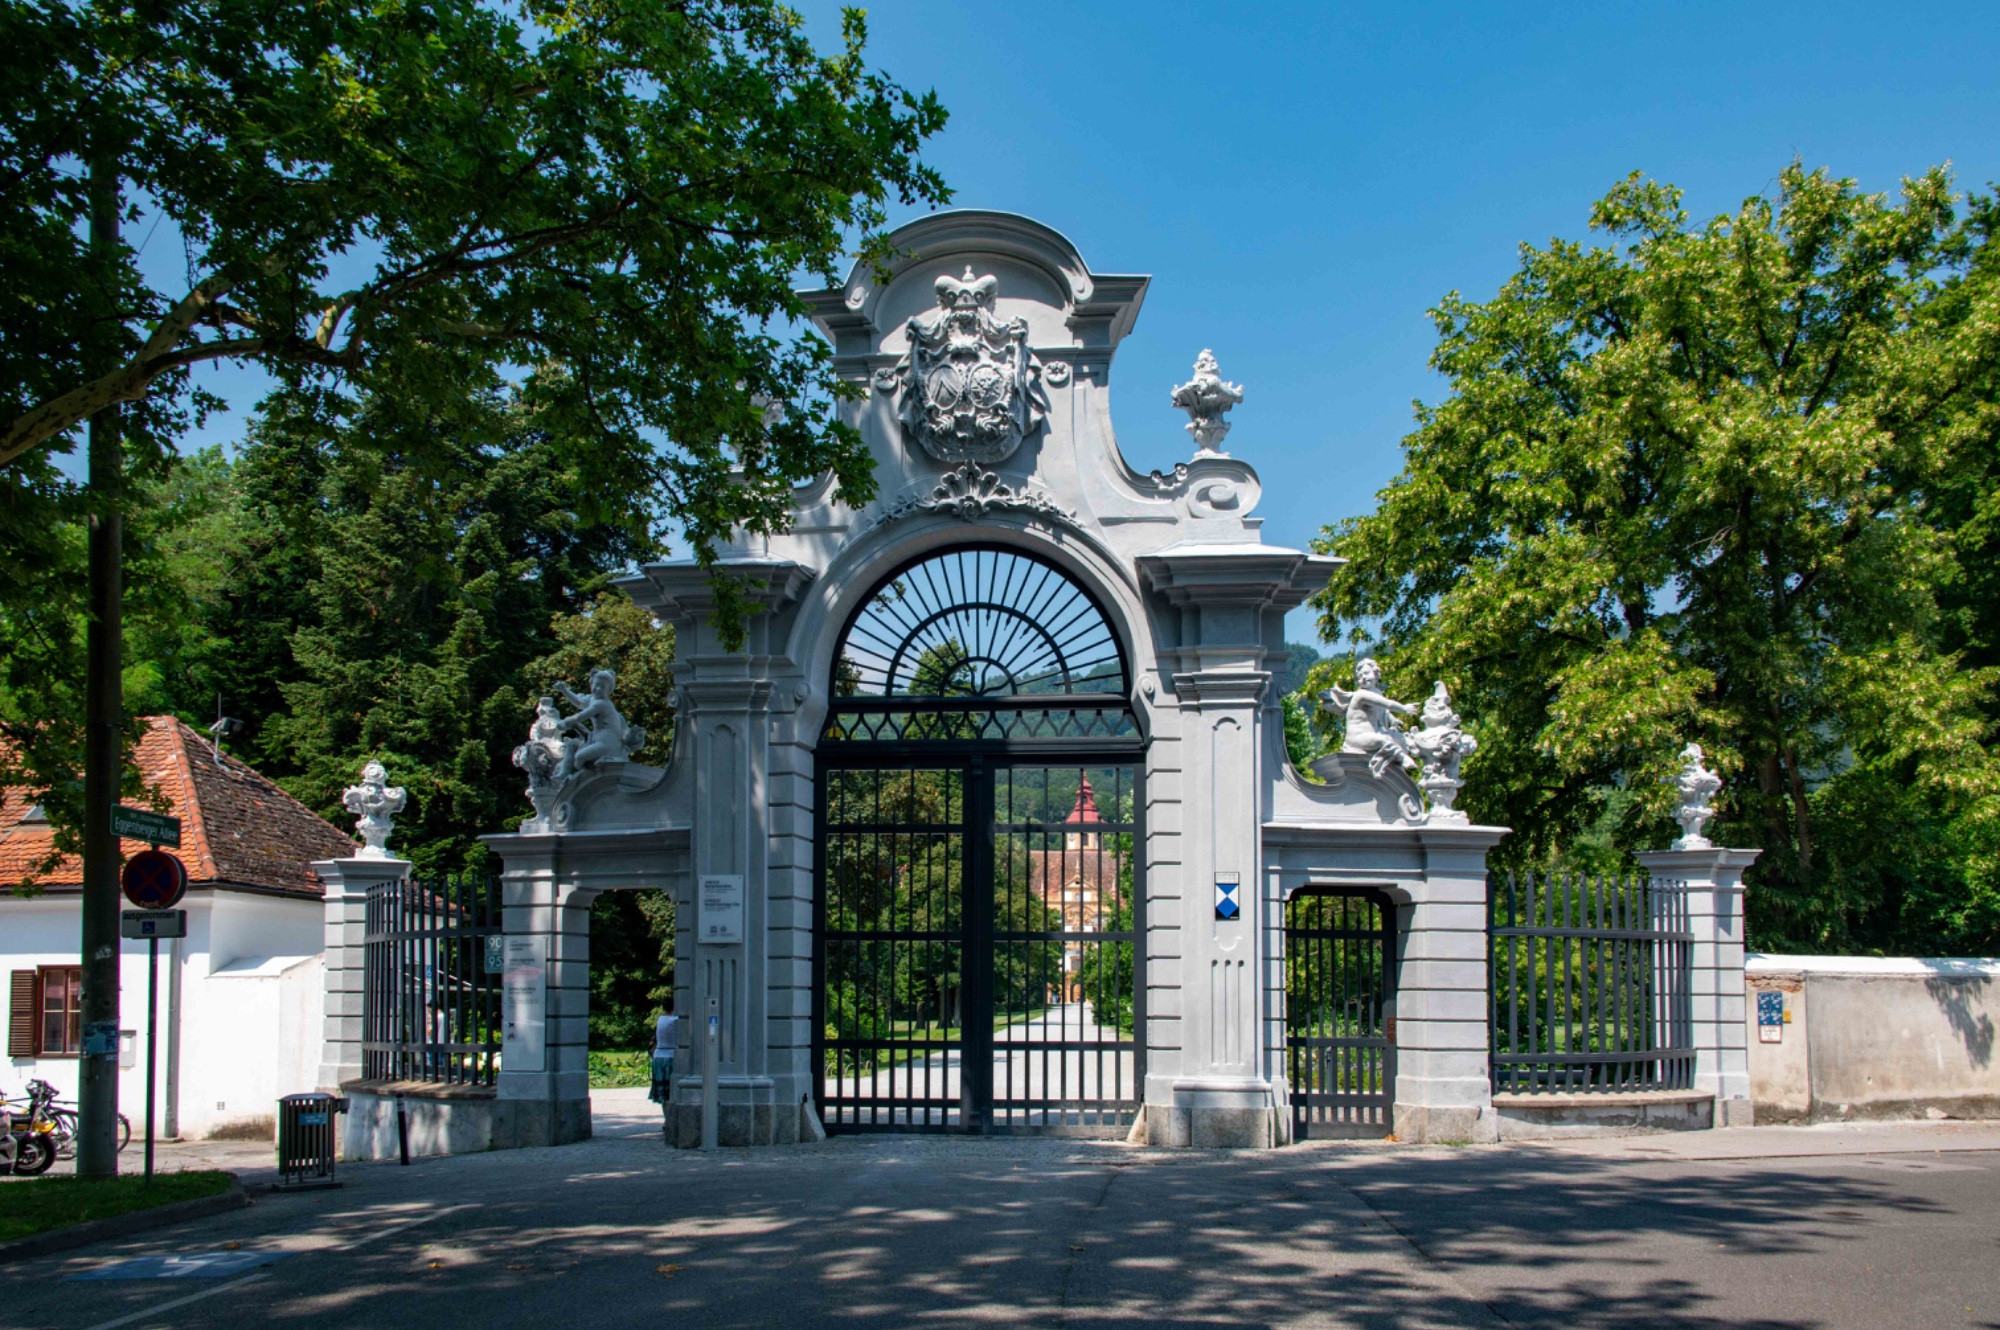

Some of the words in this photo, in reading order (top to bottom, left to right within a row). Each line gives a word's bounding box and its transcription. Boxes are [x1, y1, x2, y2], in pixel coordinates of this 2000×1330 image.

[115, 816, 158, 840] Eggenberger
[158, 826, 178, 842] Allee
[122, 911, 176, 922] ausgenommen
[489, 937, 502, 949] 90
[489, 956, 502, 968] 95
